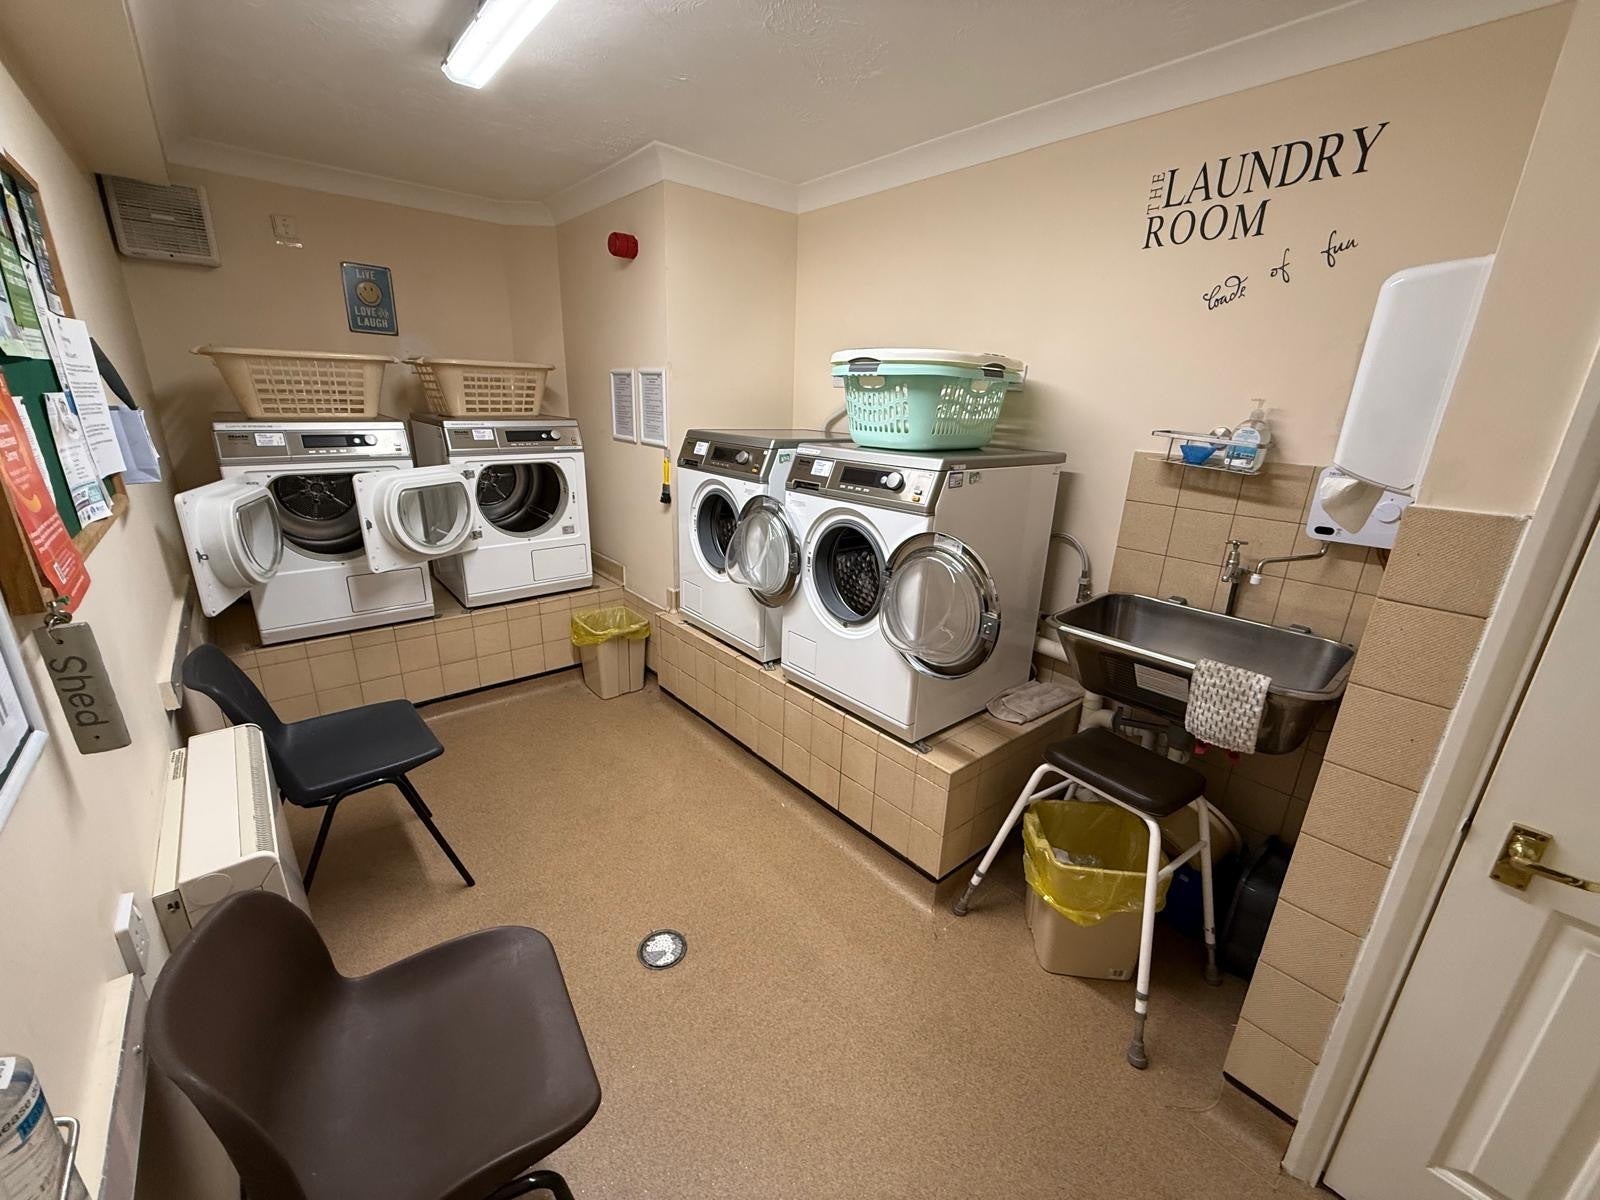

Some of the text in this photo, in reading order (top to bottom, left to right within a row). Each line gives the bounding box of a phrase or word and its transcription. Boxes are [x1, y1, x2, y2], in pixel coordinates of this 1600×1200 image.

[1161, 121, 1390, 209] LAUNDRY
[1146, 172, 1166, 216] THE
[1141, 199, 1272, 250] ROOM
[355, 268, 376, 280] LIVE
[1202, 230, 1359, 311] loads of fun
[354, 306, 377, 317] LOVE
[357, 316, 388, 328] LAUGH
[49, 655, 110, 728] Shed
